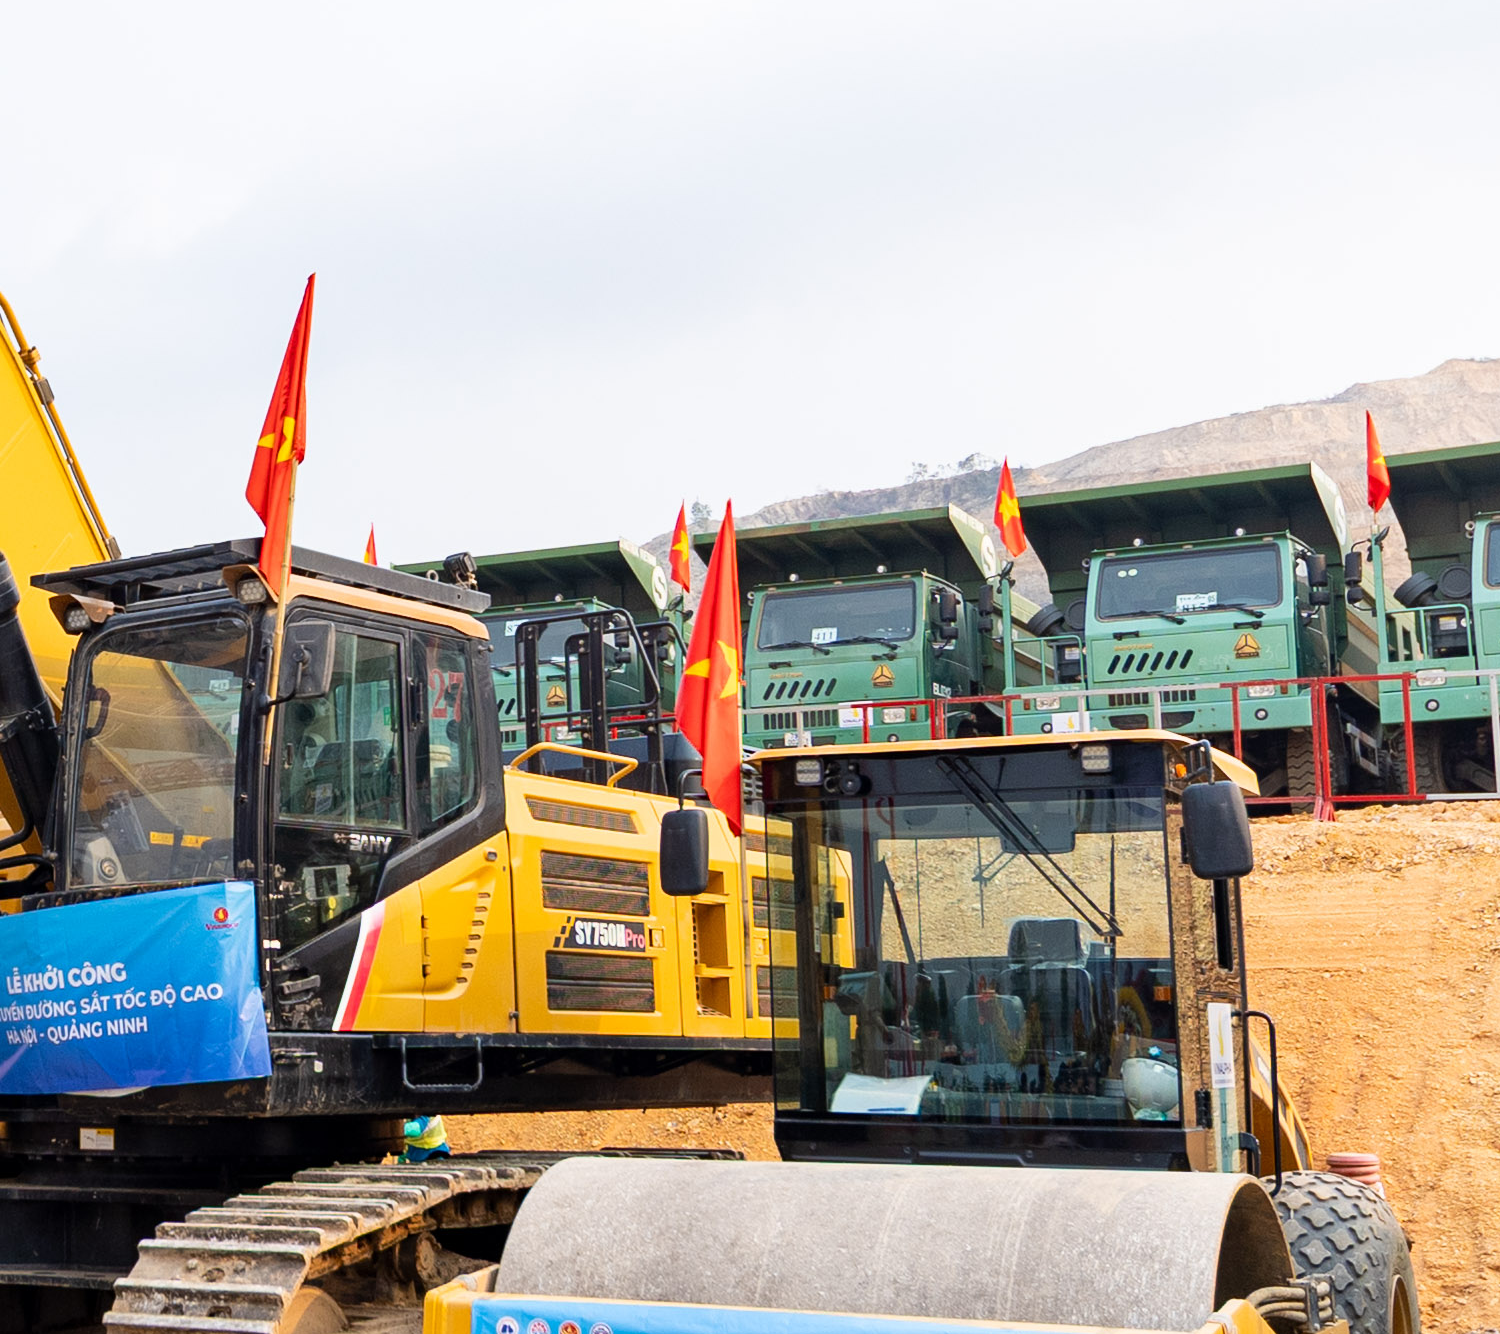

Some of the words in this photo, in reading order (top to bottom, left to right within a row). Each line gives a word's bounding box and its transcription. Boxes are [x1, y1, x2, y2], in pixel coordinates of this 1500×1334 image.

[428, 668, 465, 722] 27
[349, 833, 392, 854] SANY
[6, 967, 22, 995] LỄ
[24, 966, 64, 992] KHỞI
[67, 961, 127, 987] CÔNG
[25, 997, 77, 1021] ĐƯỜNG
[80, 990, 108, 1015] SẮT
[114, 986, 147, 1010] TỐC
[150, 983, 177, 1010] ĐỘ
[180, 983, 223, 1003] CAO
[6, 1025, 21, 1045] HÀ
[47, 1018, 103, 1044] QUẢNG
[106, 1016, 148, 1037] NINH
